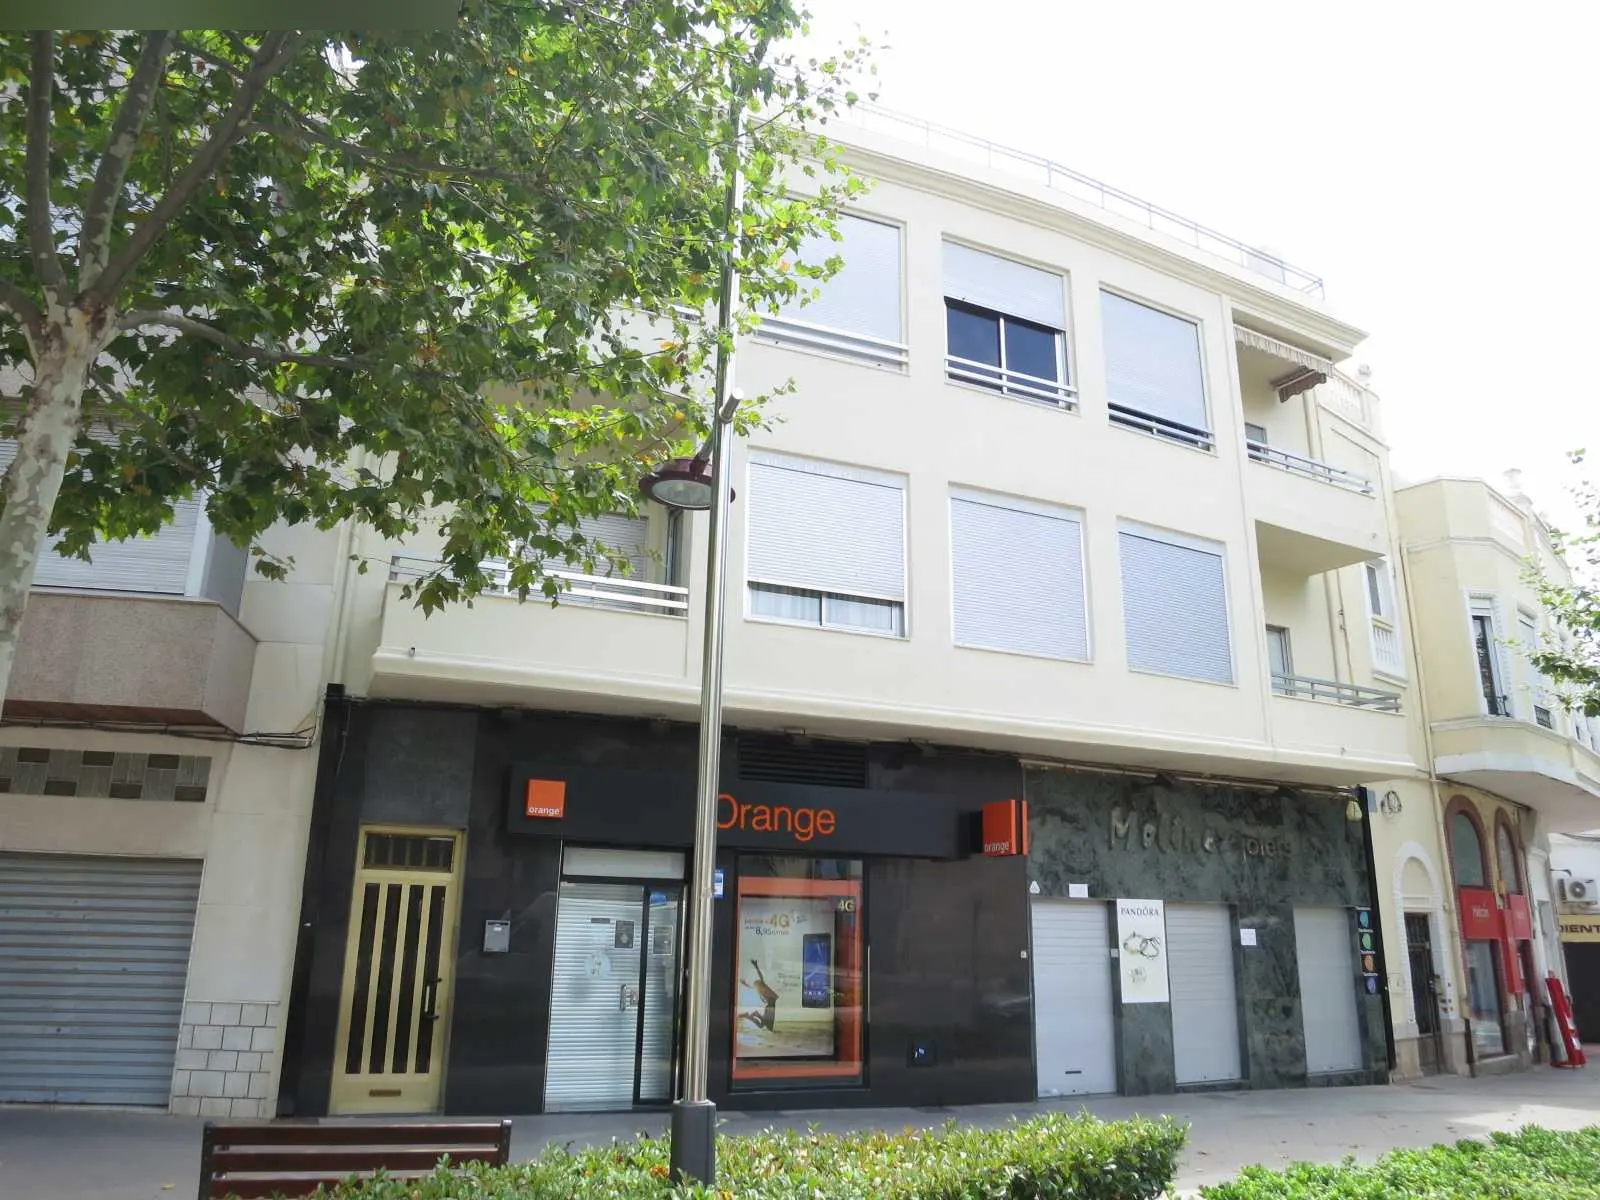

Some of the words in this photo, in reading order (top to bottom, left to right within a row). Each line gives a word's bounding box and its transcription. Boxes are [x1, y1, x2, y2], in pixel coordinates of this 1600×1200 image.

[528, 807, 561, 817] orange
[716, 793, 836, 841] Orange
[984, 841, 1010, 855] orange
[838, 900, 854, 912] 4G
